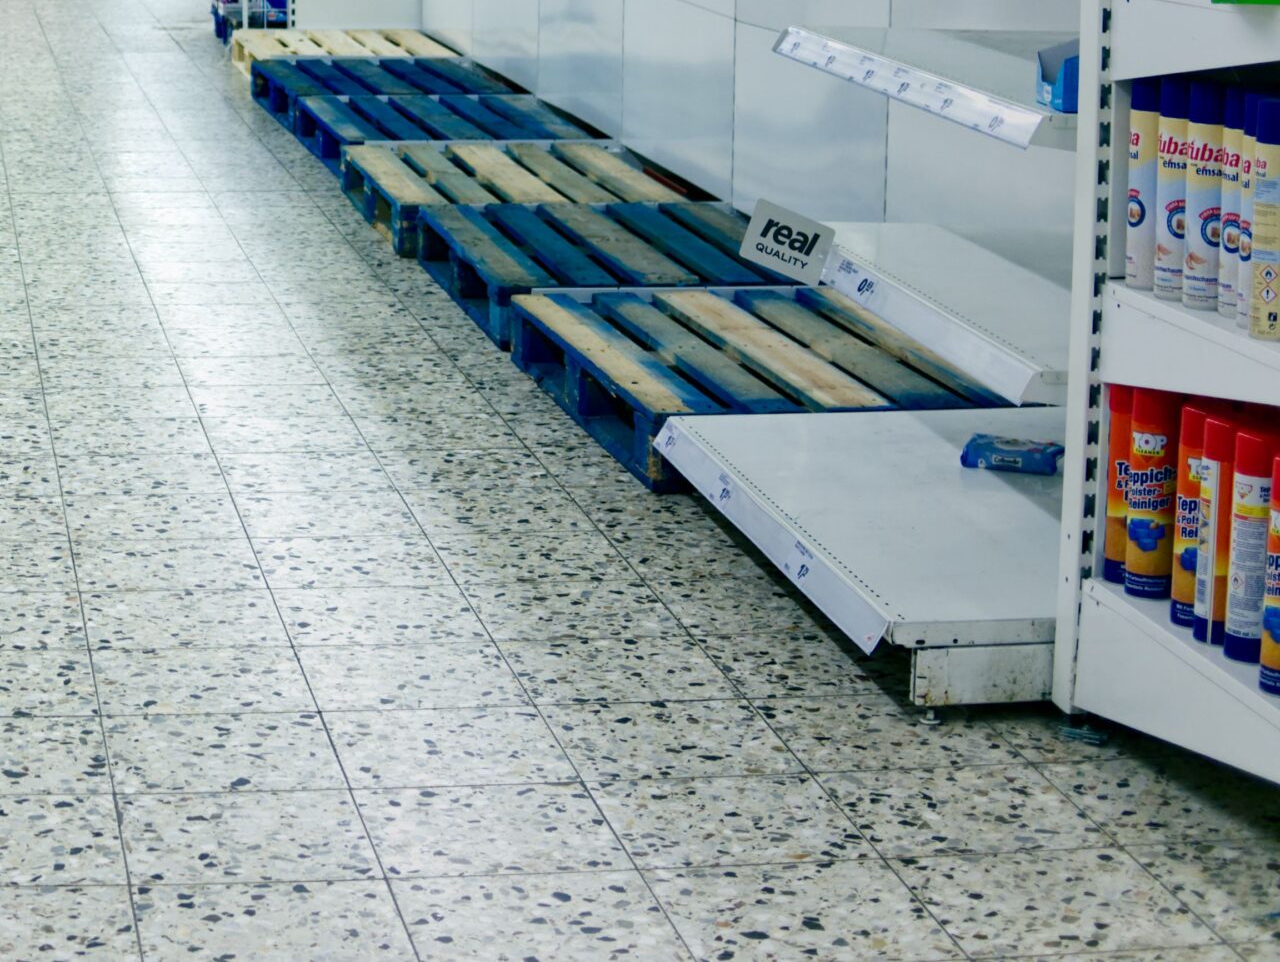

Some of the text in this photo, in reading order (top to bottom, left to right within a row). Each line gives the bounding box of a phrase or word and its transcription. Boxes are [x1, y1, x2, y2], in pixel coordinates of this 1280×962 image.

[760, 218, 821, 257] real
[755, 242, 809, 270] QUALITY
[1133, 431, 1168, 451] TOP
